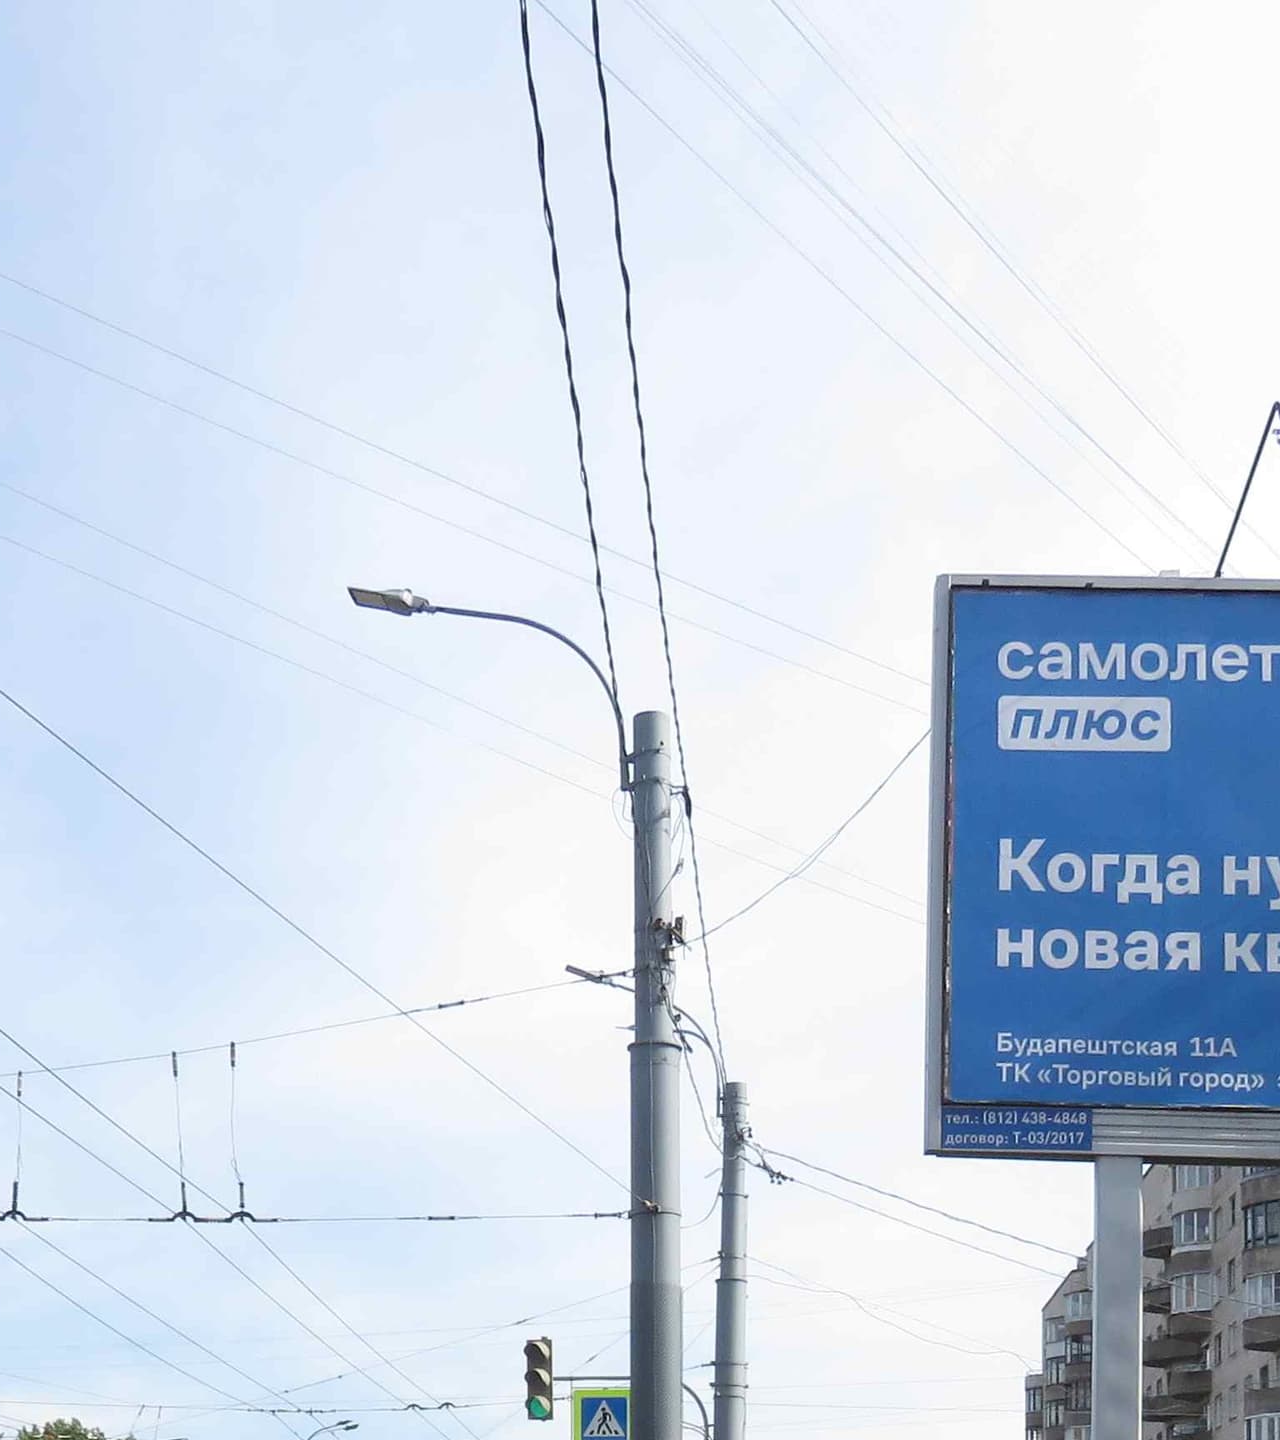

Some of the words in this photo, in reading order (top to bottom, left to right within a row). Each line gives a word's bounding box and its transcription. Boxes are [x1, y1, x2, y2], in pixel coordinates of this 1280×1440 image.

[1009, 707, 1161, 742] плюс
[997, 837, 1201, 904] Когда
[996, 927, 1202, 972] новая
[996, 1032, 1178, 1057] Будапештская
[1189, 1037, 1238, 1058] 11А
[995, 1062, 1031, 1084] ТК
[1037, 1063, 1172, 1090] «Торговый
[1178, 1070, 1265, 1093] город»
[983, 1111, 1018, 1125] (812)
[1021, 1111, 1088, 1126] 438-4848
[944, 1133, 1009, 1147] договор:
[1012, 1131, 1085, 1145] Т-03/2017
